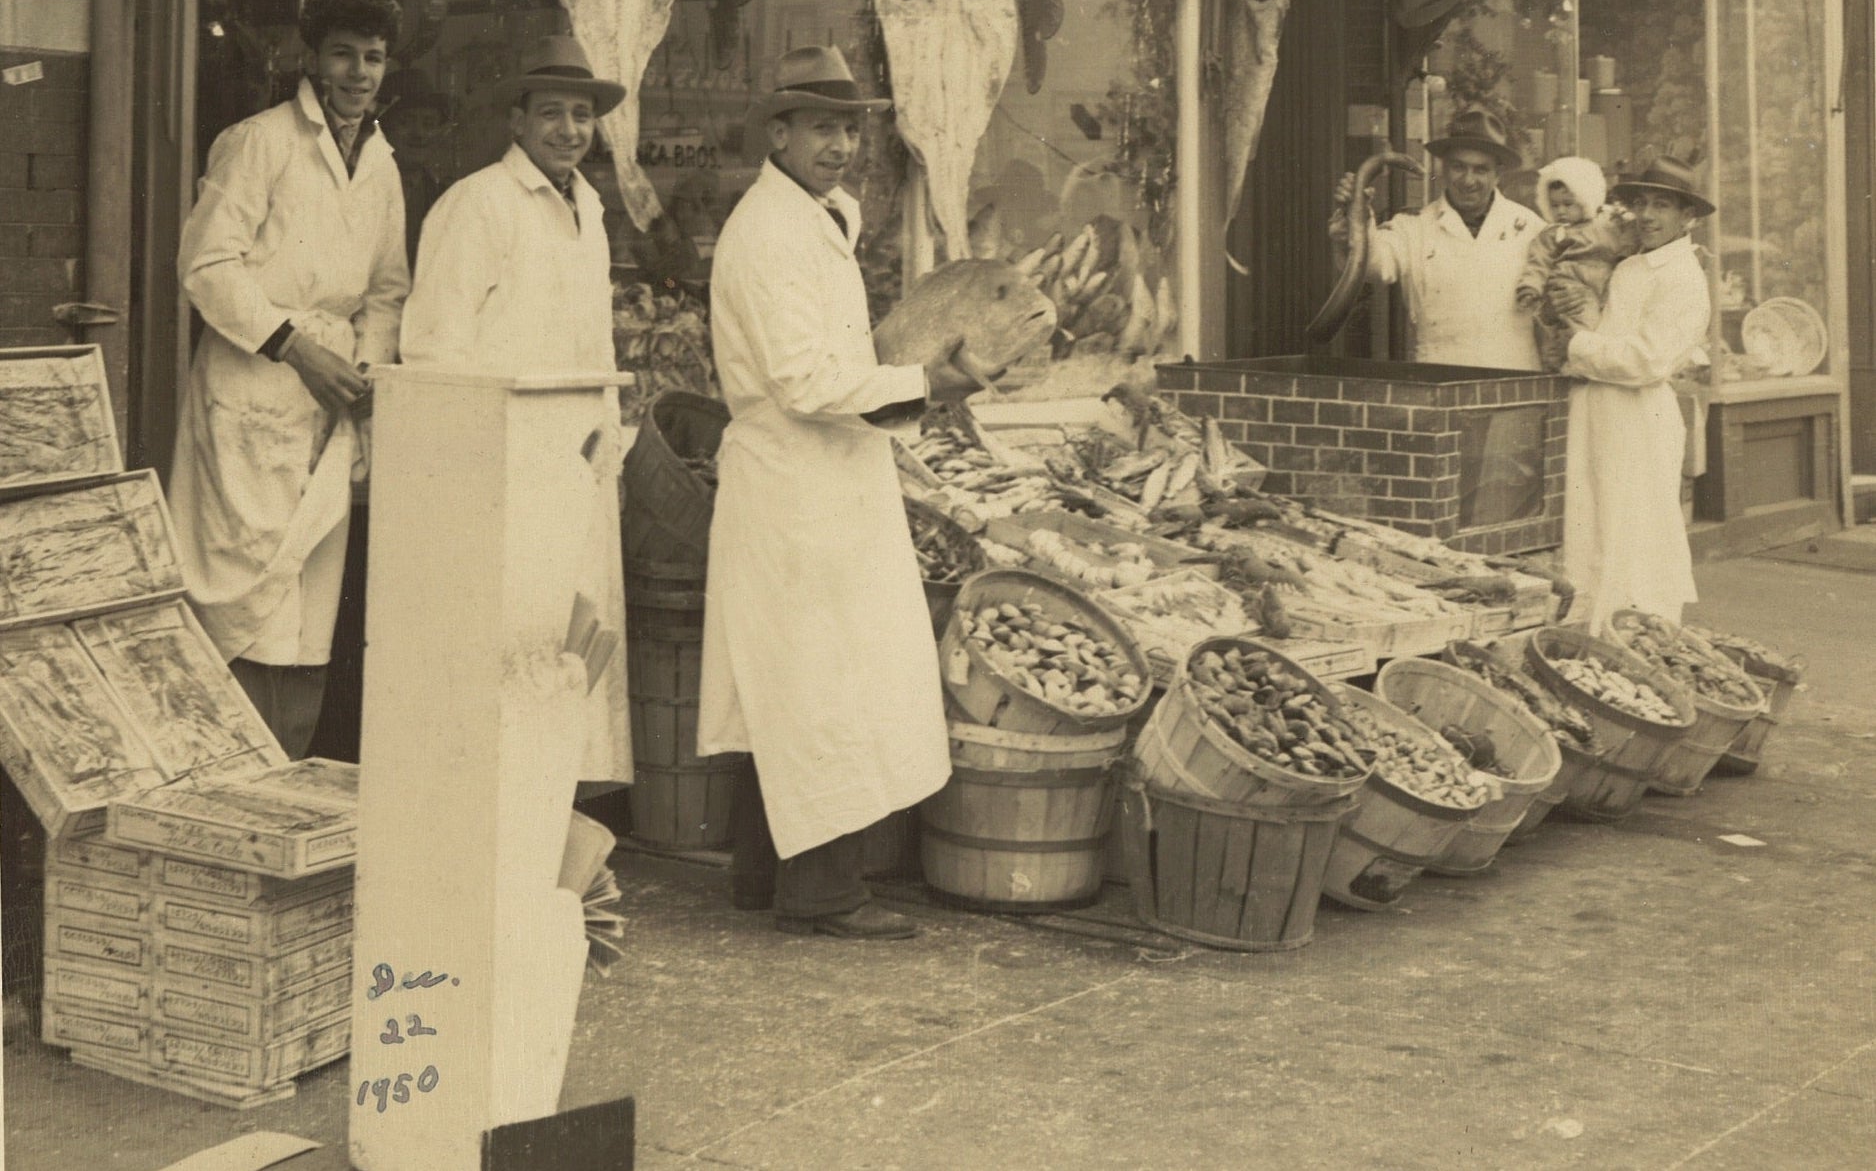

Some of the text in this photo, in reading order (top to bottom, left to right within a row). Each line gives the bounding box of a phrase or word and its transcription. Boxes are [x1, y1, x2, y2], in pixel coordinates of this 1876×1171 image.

[367, 963, 460, 1000] Dec.
[379, 1014, 438, 1045] 22
[356, 1064, 440, 1114] 1950
